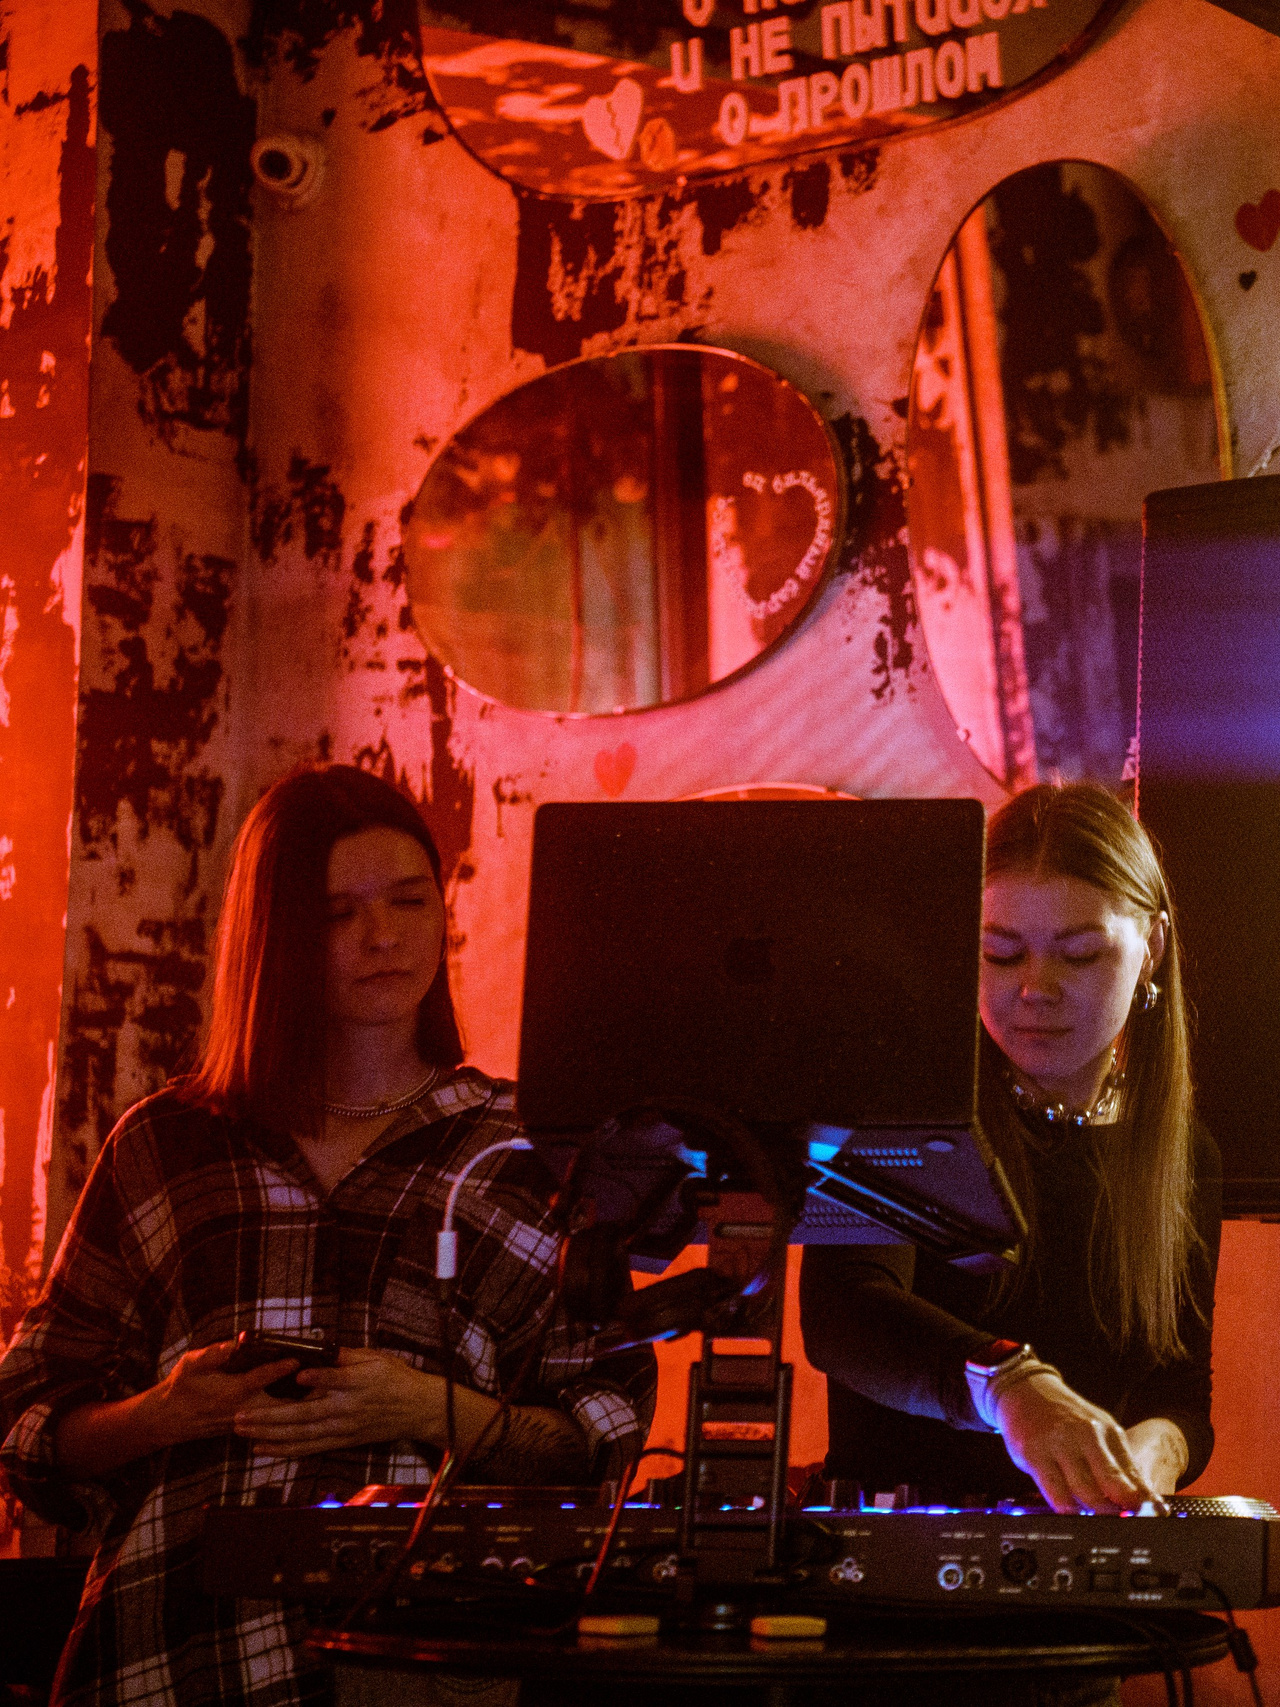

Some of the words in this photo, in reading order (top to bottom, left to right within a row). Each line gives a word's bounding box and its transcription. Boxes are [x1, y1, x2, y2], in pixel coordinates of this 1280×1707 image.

[719, 91, 748, 146] О
[777, 31, 1003, 134] ПРОШЛОМ
[730, 15, 794, 81] НЕ
